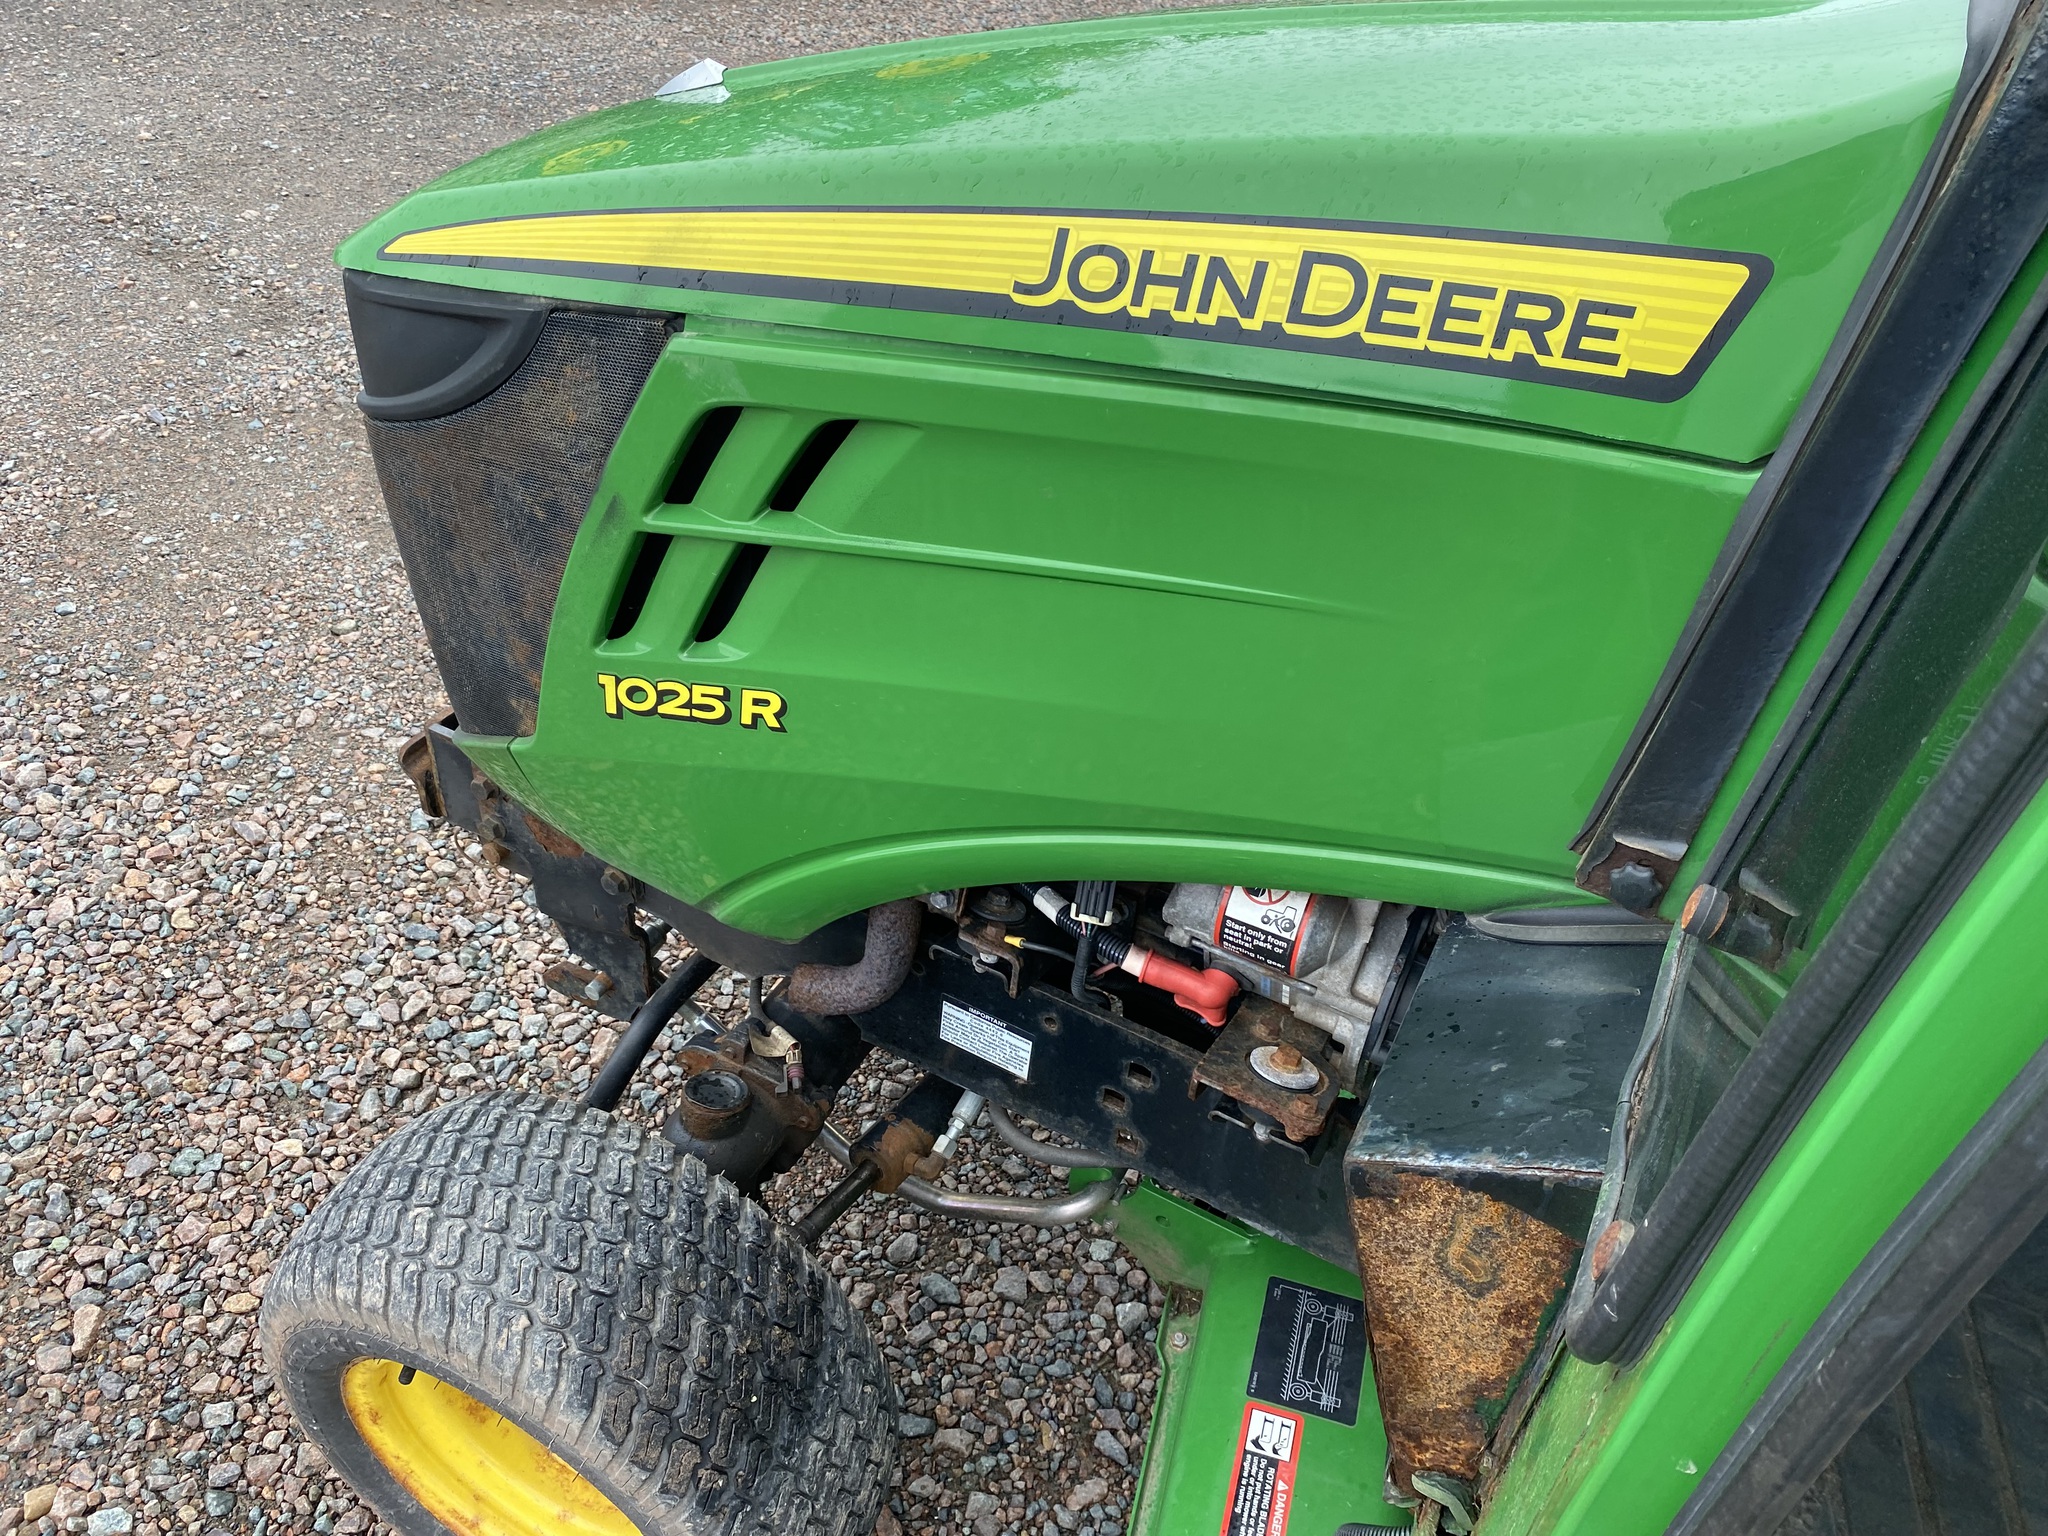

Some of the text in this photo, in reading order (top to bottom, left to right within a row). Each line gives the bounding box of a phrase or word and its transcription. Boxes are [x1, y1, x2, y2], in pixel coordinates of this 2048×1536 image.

[1012, 227, 1637, 366] JOHN DEERE
[598, 673, 788, 733] 1025 R
[1224, 928, 1242, 938] seat
[1244, 934, 1251, 942] in
[1253, 939, 1272, 950] park
[1224, 934, 1254, 949] neutral.
[1226, 919, 1287, 948] Start only from
[1223, 941, 1255, 957] Starting
[1267, 959, 1285, 968] gear
[968, 1006, 1006, 1028] IMPORTANT
[1240, 1453, 1252, 1477] engine
[1249, 1456, 1259, 1476] under
[1259, 1458, 1267, 1468] Do
[1248, 1477, 1255, 1485] or
[1256, 1469, 1264, 1481] not
[1245, 1486, 1254, 1499] into
[1253, 1481, 1262, 1494] put
[1260, 1466, 1275, 1509] ROTATING
[1233, 1485, 1246, 1513] running
[1250, 1494, 1260, 1516] hands
[1240, 1501, 1250, 1525] mower
[1248, 1517, 1255, 1526] or
